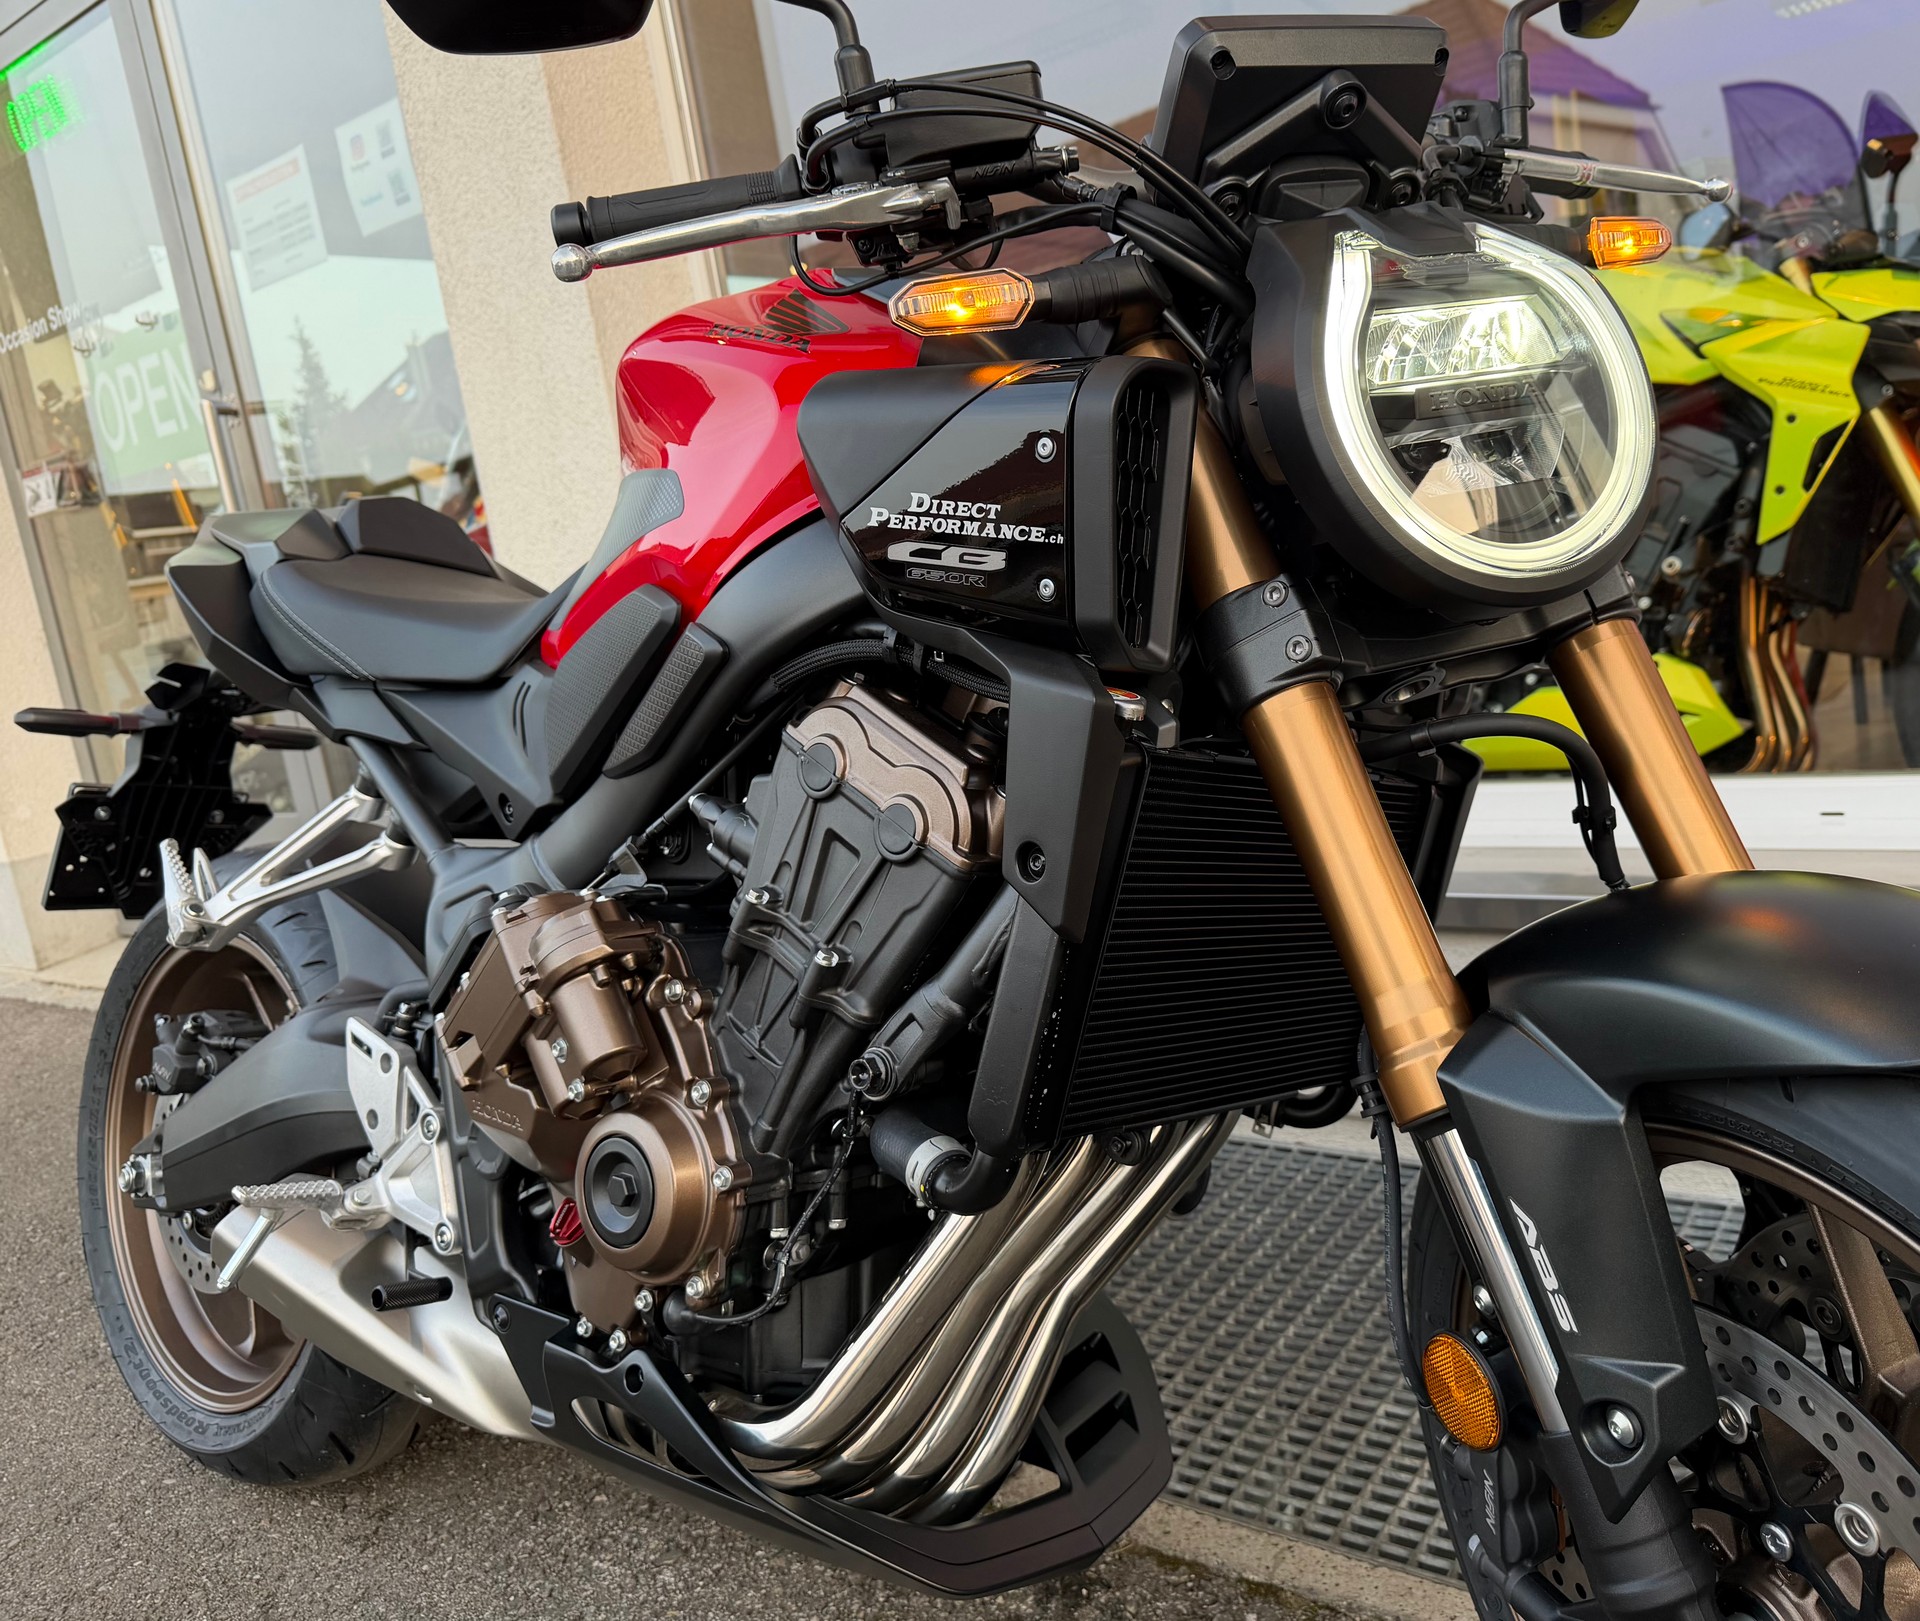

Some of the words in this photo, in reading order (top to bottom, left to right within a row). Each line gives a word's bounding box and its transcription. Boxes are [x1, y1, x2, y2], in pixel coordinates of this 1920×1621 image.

[0, 317, 48, 354] Occasion
[706, 323, 811, 354] HONDA
[95, 342, 204, 452] OPEN
[907, 492, 1001, 520] DIRECT
[888, 541, 1007, 571] CB
[907, 567, 986, 588] 650R
[472, 1099, 524, 1132] HONDA
[1509, 1198, 1579, 1333] ABS
